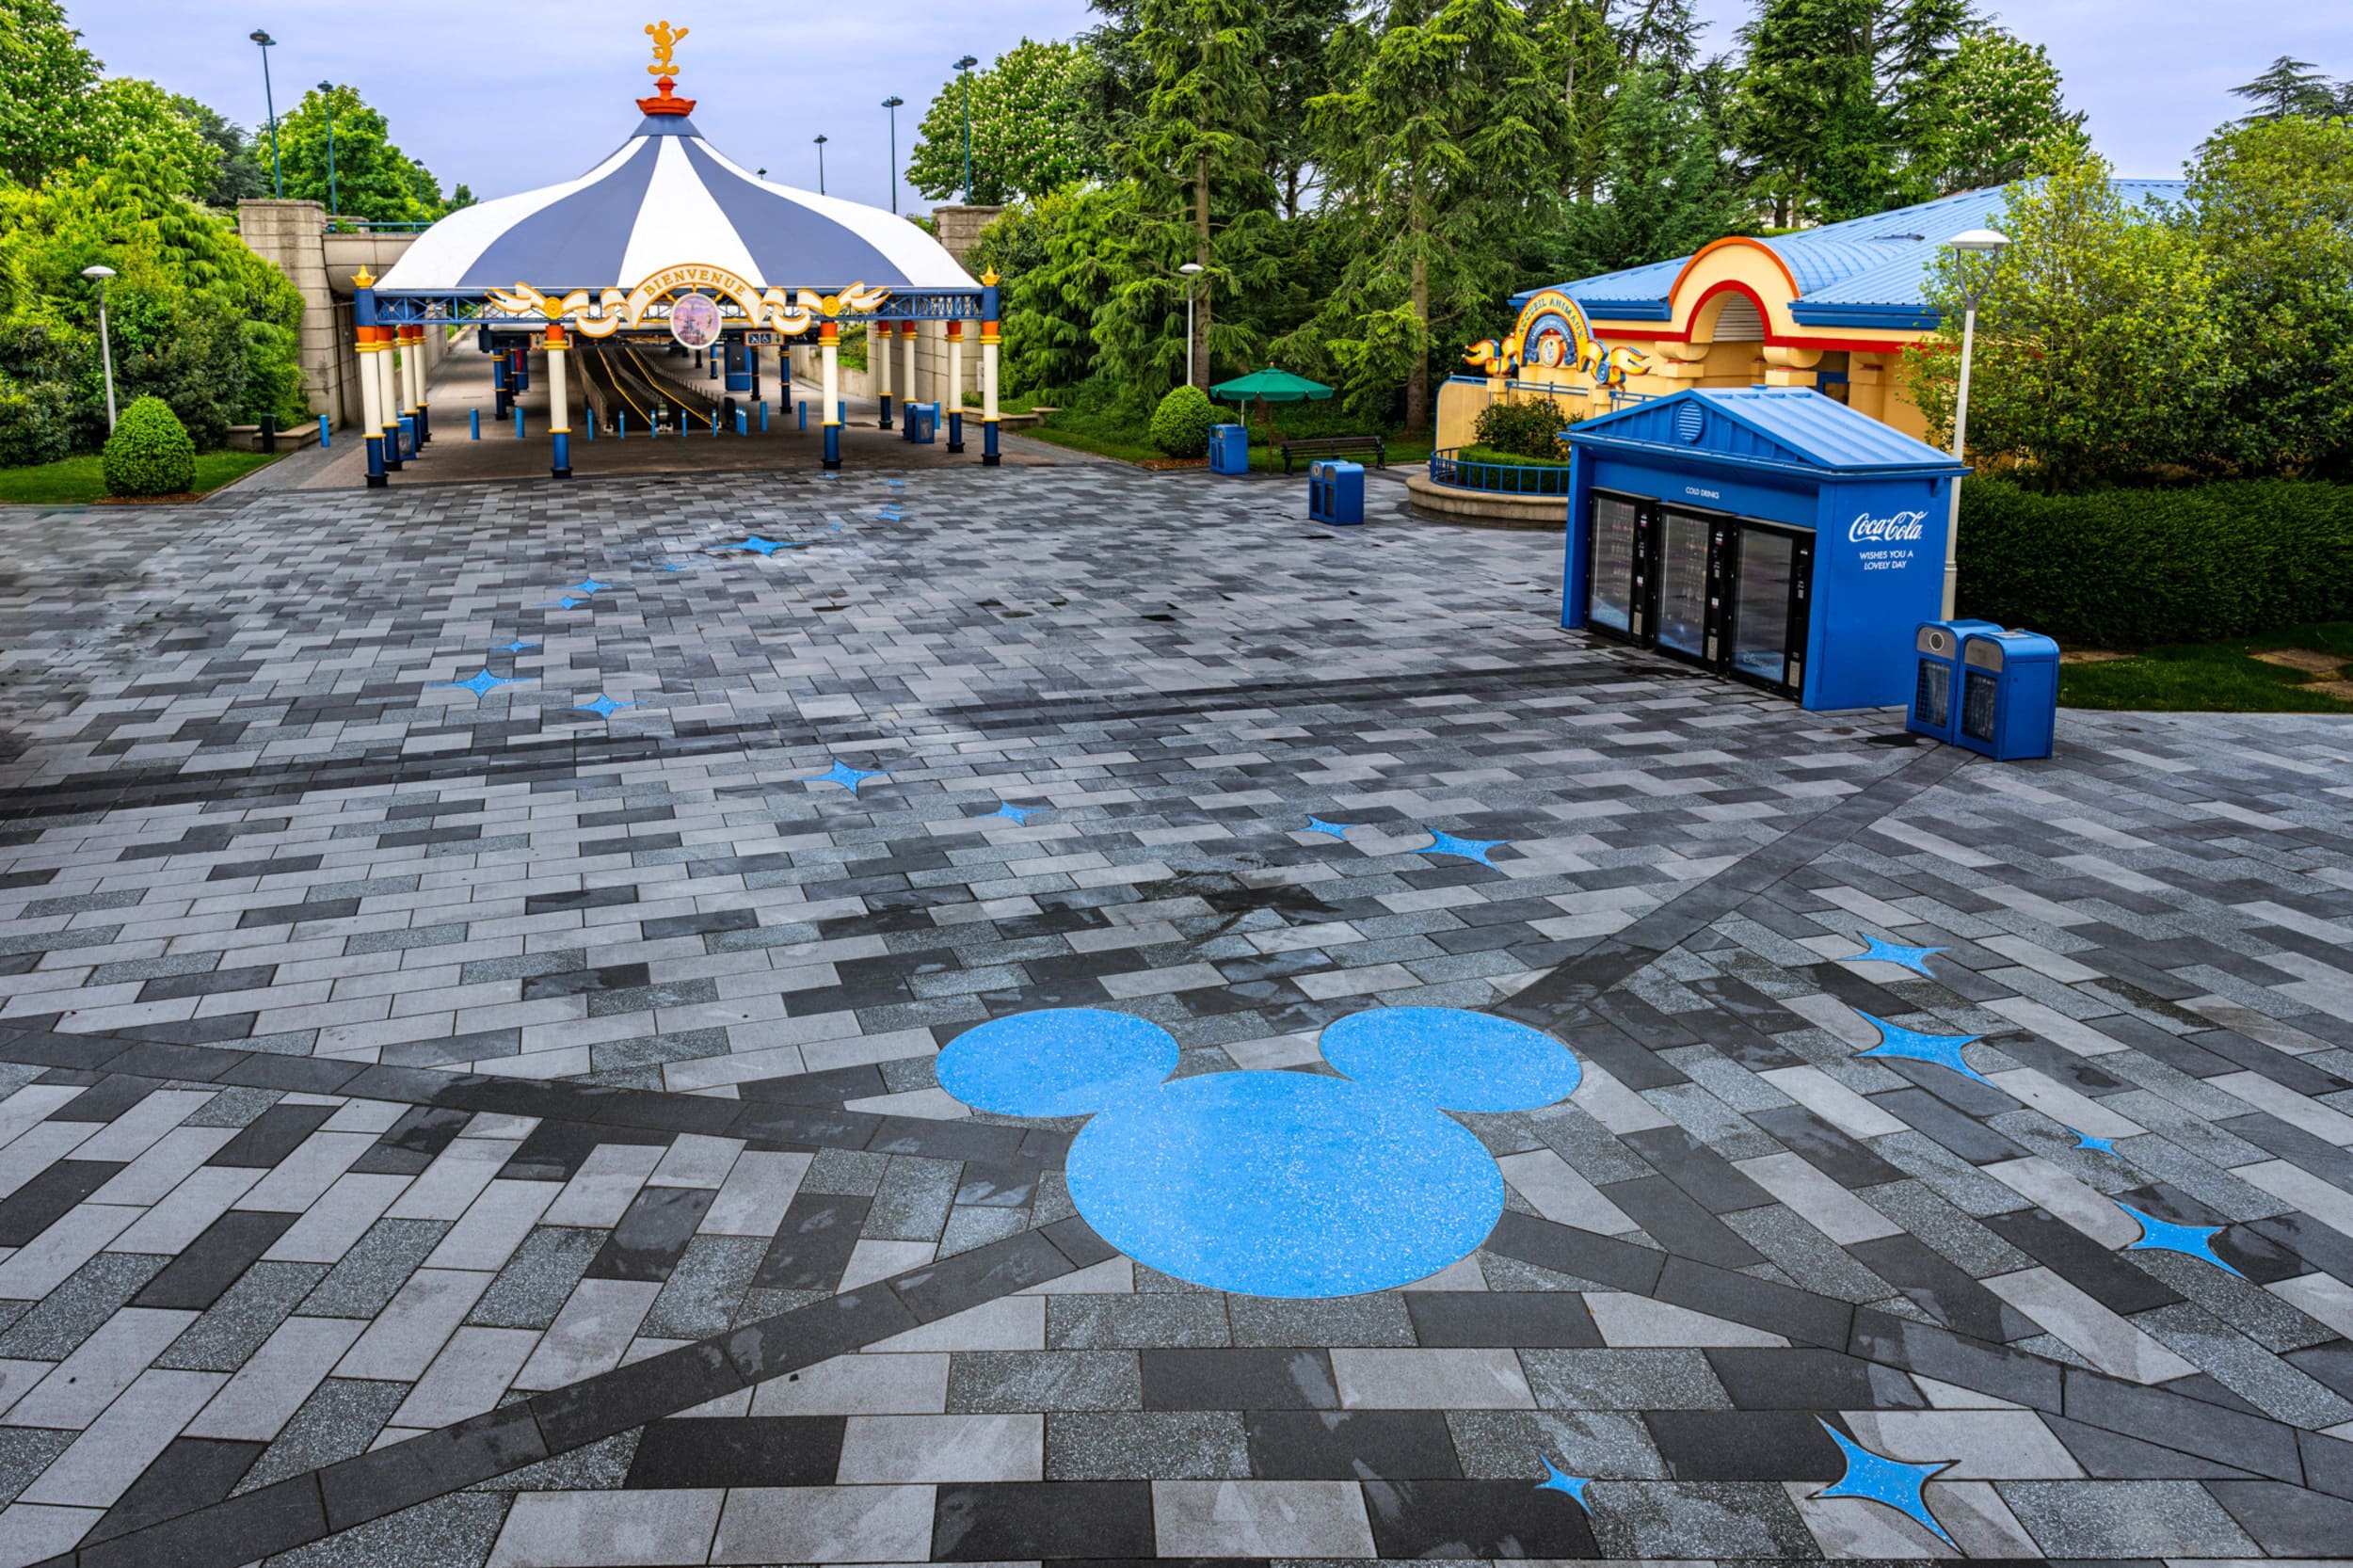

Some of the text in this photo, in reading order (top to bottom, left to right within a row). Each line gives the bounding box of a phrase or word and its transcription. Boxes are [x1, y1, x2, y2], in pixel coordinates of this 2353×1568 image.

[643, 269, 746, 296] BIENVENUE
[1519, 297, 1546, 336] ACCUEIL
[1549, 296, 1584, 339] ANIMAUX
[1686, 487, 1699, 495] COLD
[1849, 511, 1928, 542] Coca-Cola
[1859, 550, 1913, 560] WISHES YOU A
[1865, 560, 1907, 570] LOVELY DAY
